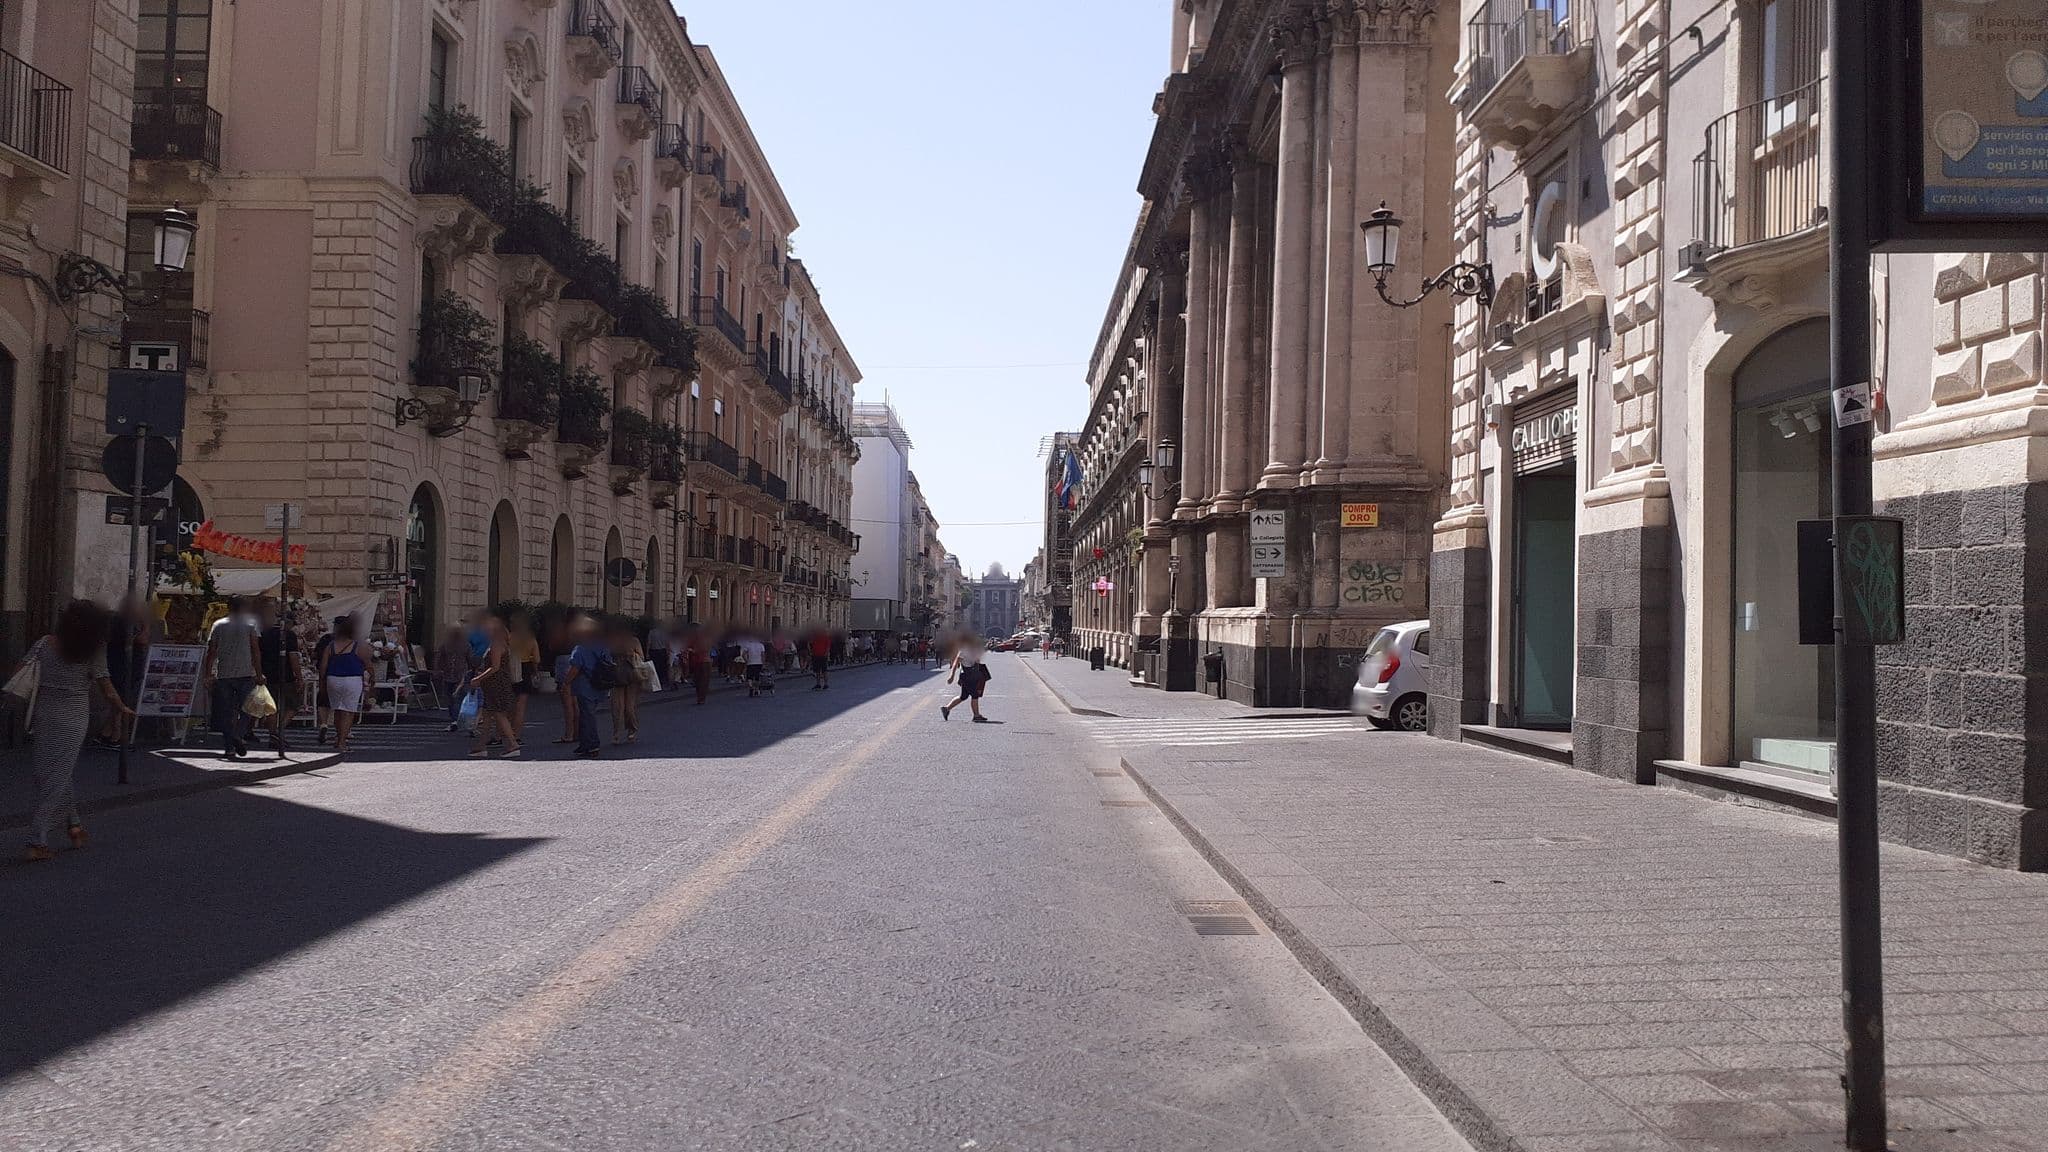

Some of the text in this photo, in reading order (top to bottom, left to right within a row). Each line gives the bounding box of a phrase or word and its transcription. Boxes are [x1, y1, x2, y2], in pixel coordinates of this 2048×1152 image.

[1983, 130, 2033, 141] servizio
[1987, 159, 2016, 173] ogni
[2020, 159, 2028, 170] 5
[1932, 194, 1977, 205] CATANIA
[1512, 405, 1577, 452] CALLIOPE
[1343, 504, 1377, 513] COMPRO
[1349, 513, 1370, 522] ORO
